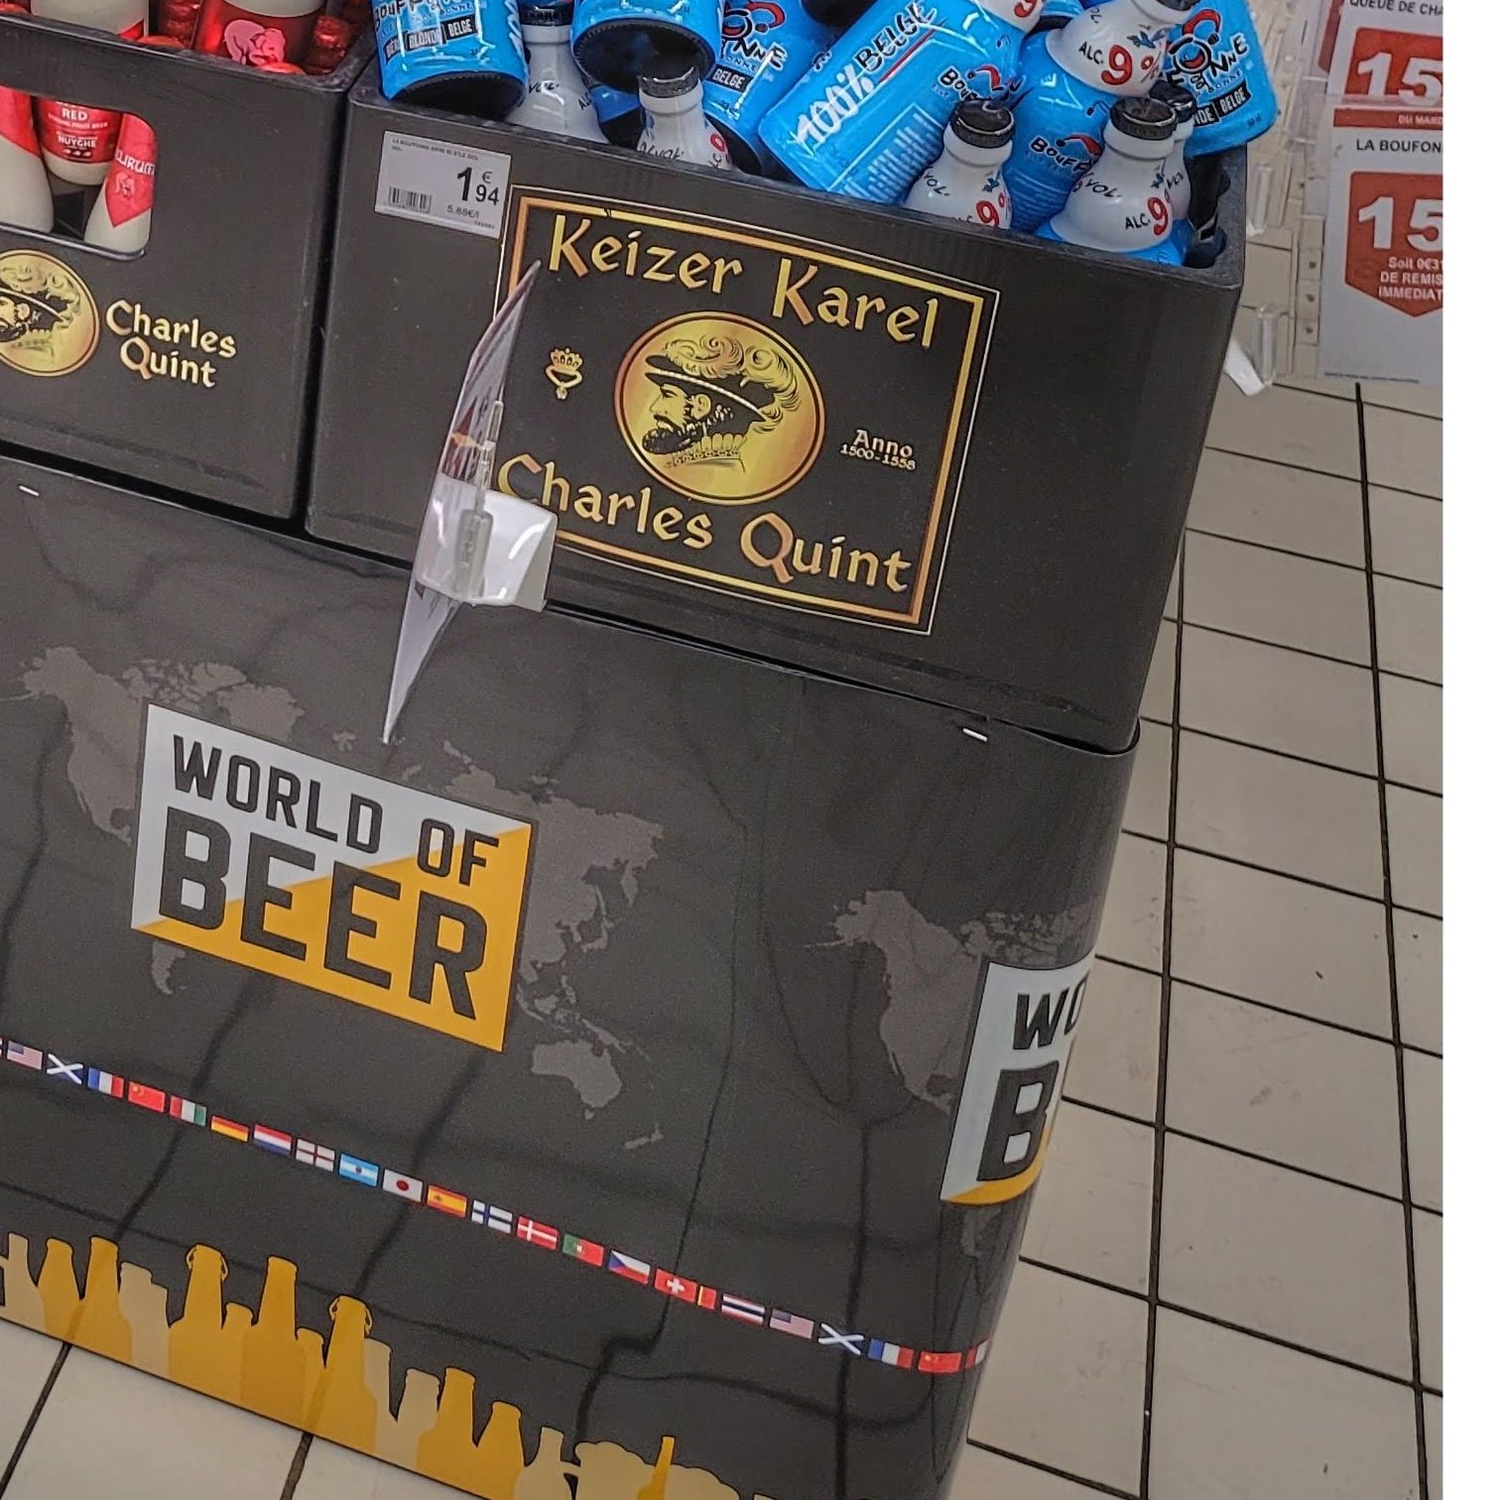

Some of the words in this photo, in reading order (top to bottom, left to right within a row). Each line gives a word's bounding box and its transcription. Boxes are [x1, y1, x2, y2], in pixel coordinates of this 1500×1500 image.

[1398, 1, 1416, 14] DE
[446, 18, 474, 39] BELGE
[856, 5, 938, 73] BELGE
[712, 68, 747, 88] BELGE
[1100, 44, 1164, 86] 9%
[1220, 86, 1246, 112] BELGE
[61, 107, 89, 122] RED
[56, 133, 98, 149] HUYGHE
[1356, 138, 1375, 152] LA
[457, 166, 500, 206] 1€94
[1380, 271, 1399, 284] DE
[1388, 256, 1413, 270] Soit
[548, 213, 743, 294] Keizer
[770, 258, 938, 349] Karel
[105, 299, 237, 359] Charles
[120, 336, 216, 388] Quint
[841, 443, 917, 471] 1500-1558
[853, 428, 914, 460] Anno
[499, 452, 714, 550] Charles
[740, 510, 911, 594] Quint
[173, 733, 382, 855] WORLD
[417, 816, 500, 887] OF
[158, 806, 489, 1022] BEER
